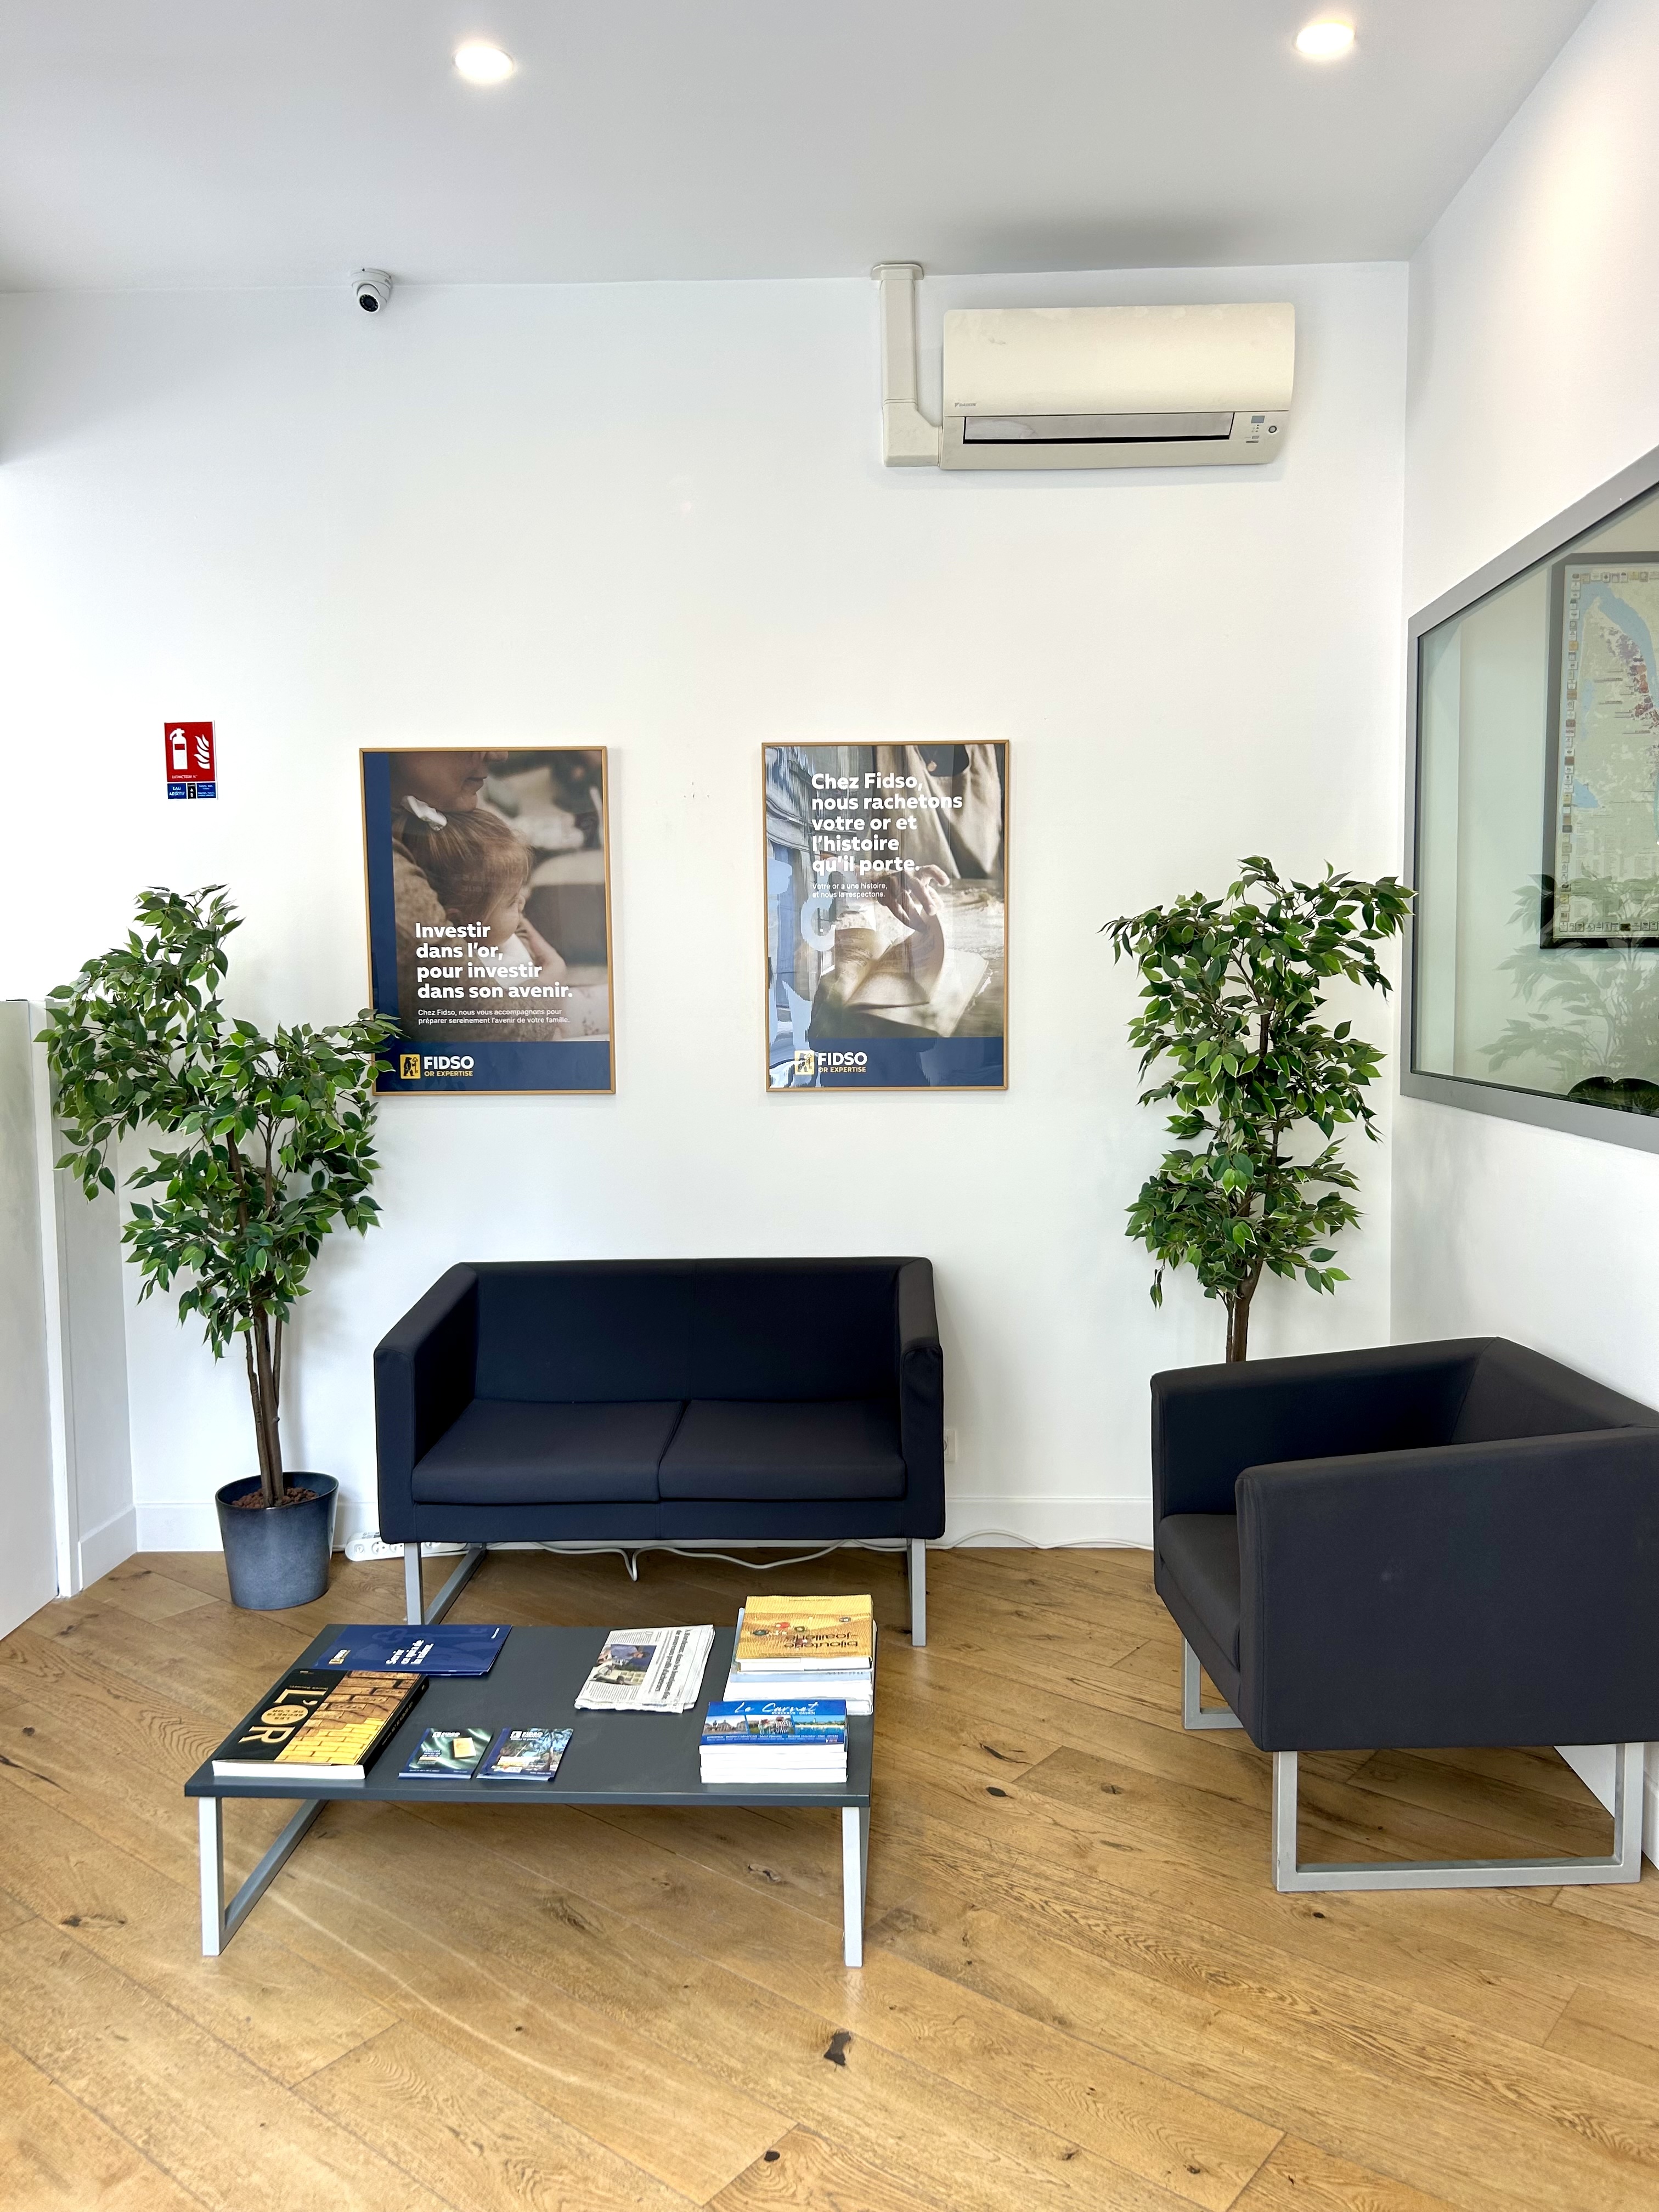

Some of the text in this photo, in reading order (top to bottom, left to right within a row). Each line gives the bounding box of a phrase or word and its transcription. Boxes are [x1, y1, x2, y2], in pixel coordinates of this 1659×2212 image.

[811, 772, 923, 791] Chez Fidso,
[812, 793, 963, 810] nous rachetons
[812, 815, 917, 831] votre or et
[860, 856, 920, 876] porte.
[415, 921, 490, 938] Investir
[416, 943, 463, 958] dans
[417, 961, 542, 983] pour investir
[417, 981, 573, 998] dans son avenir.
[424, 1056, 475, 1069] FIDSO
[817, 1052, 867, 1065] FIDSO
[784, 1640, 858, 1649] bijouterie
[734, 1701, 819, 1713] Le Carnet
